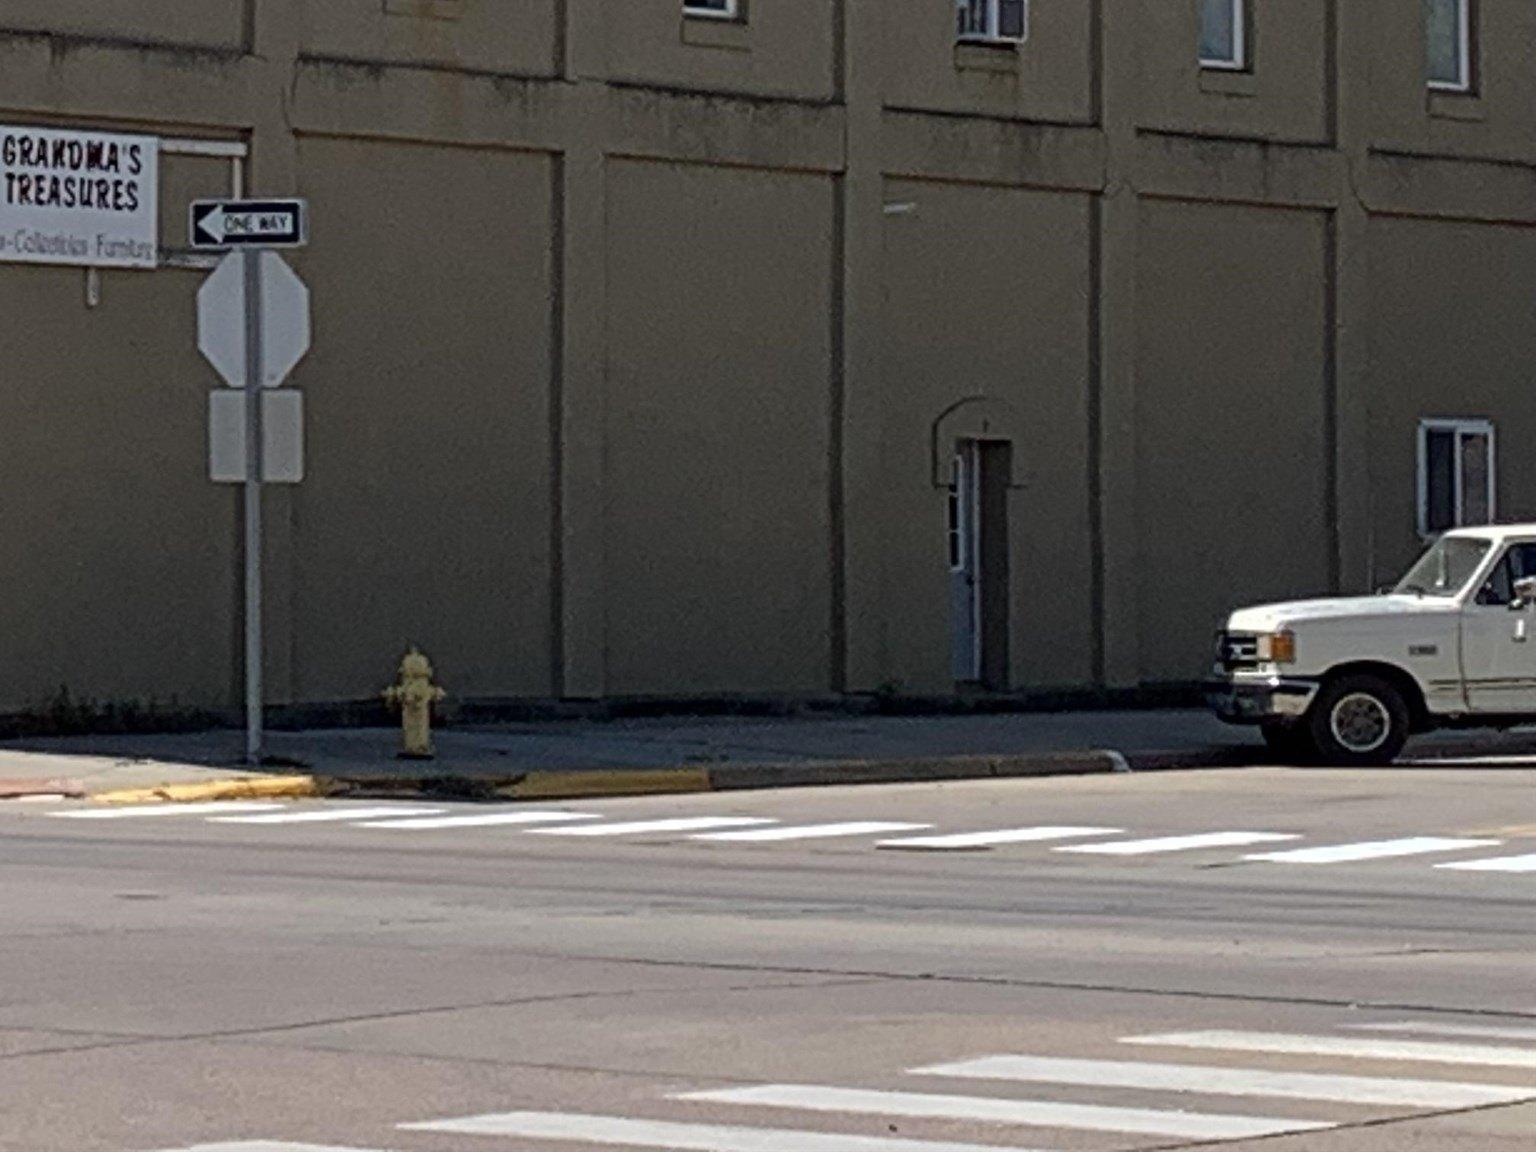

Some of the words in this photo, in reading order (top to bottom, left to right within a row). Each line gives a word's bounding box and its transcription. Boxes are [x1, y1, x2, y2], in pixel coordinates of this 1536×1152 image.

[2, 134, 142, 176] GRANDMA'S
[5, 172, 139, 211] TREASURES
[224, 214, 253, 233] ONE
[259, 214, 289, 231] WAY
